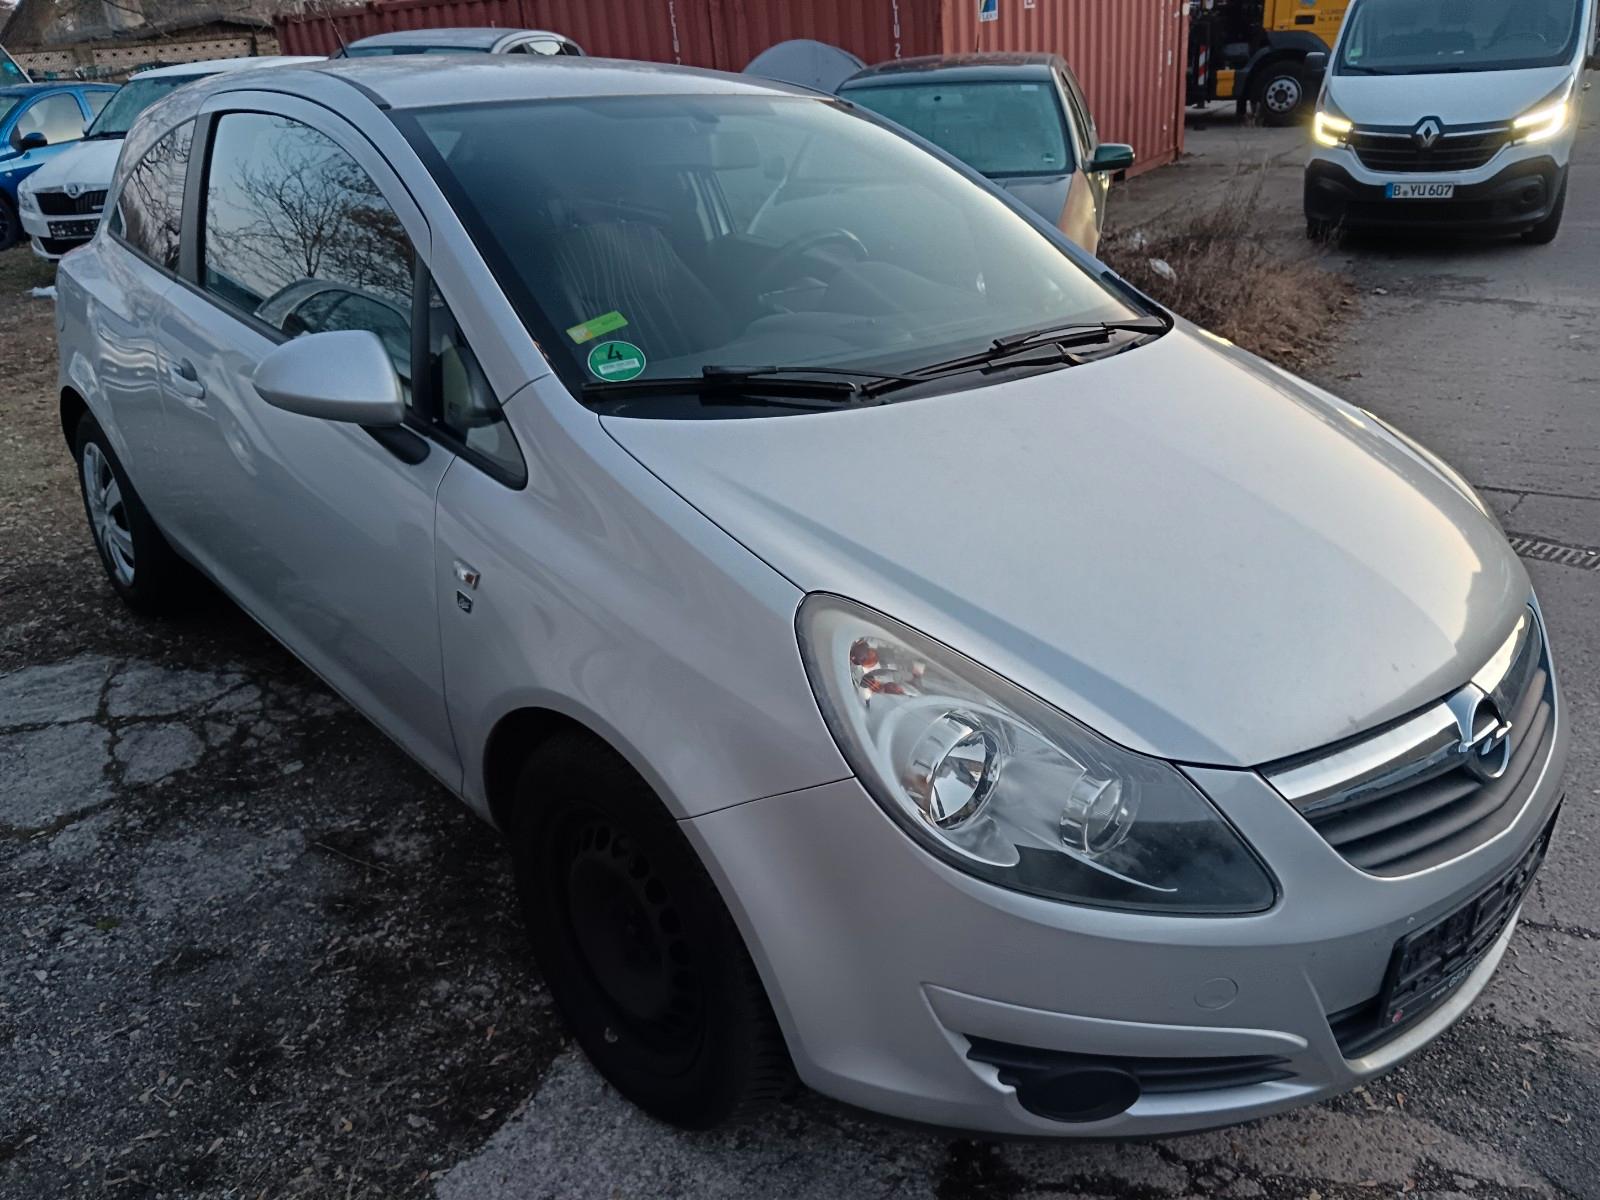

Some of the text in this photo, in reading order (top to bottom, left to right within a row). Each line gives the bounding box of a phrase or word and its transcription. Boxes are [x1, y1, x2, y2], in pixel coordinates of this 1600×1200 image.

[1393, 184, 1452, 196] B YU 607
[607, 343, 624, 361] 4
